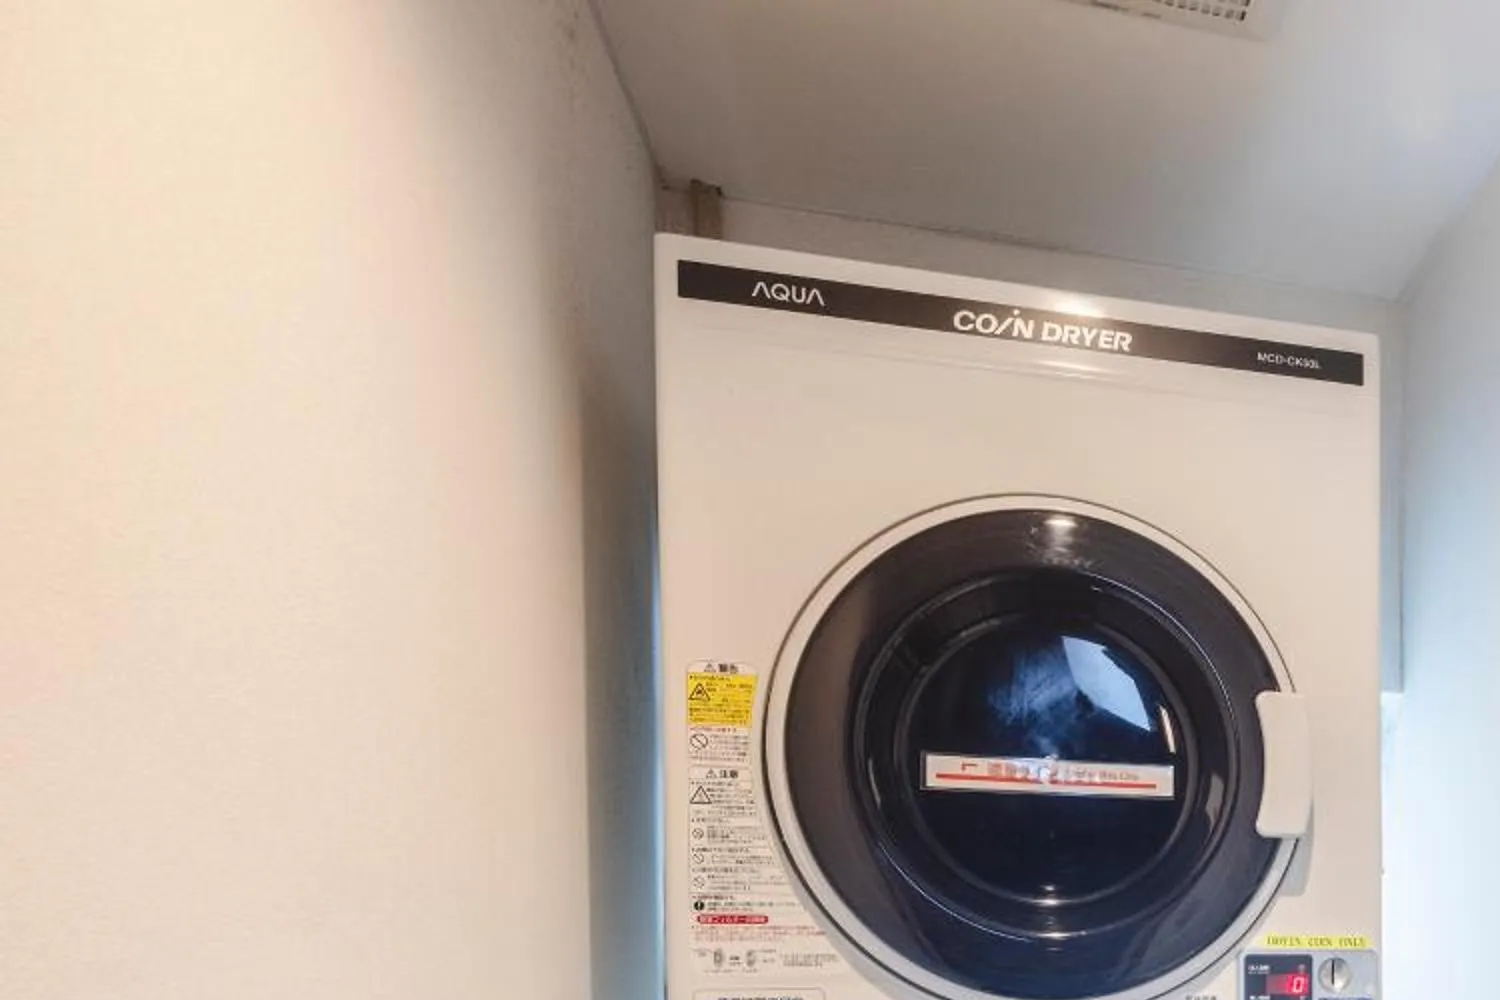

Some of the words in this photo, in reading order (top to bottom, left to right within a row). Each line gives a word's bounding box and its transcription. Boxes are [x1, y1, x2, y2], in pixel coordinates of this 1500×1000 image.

[751, 280, 825, 307] AQUA
[953, 305, 1036, 339] COIN
[1041, 320, 1133, 353] DRYER
